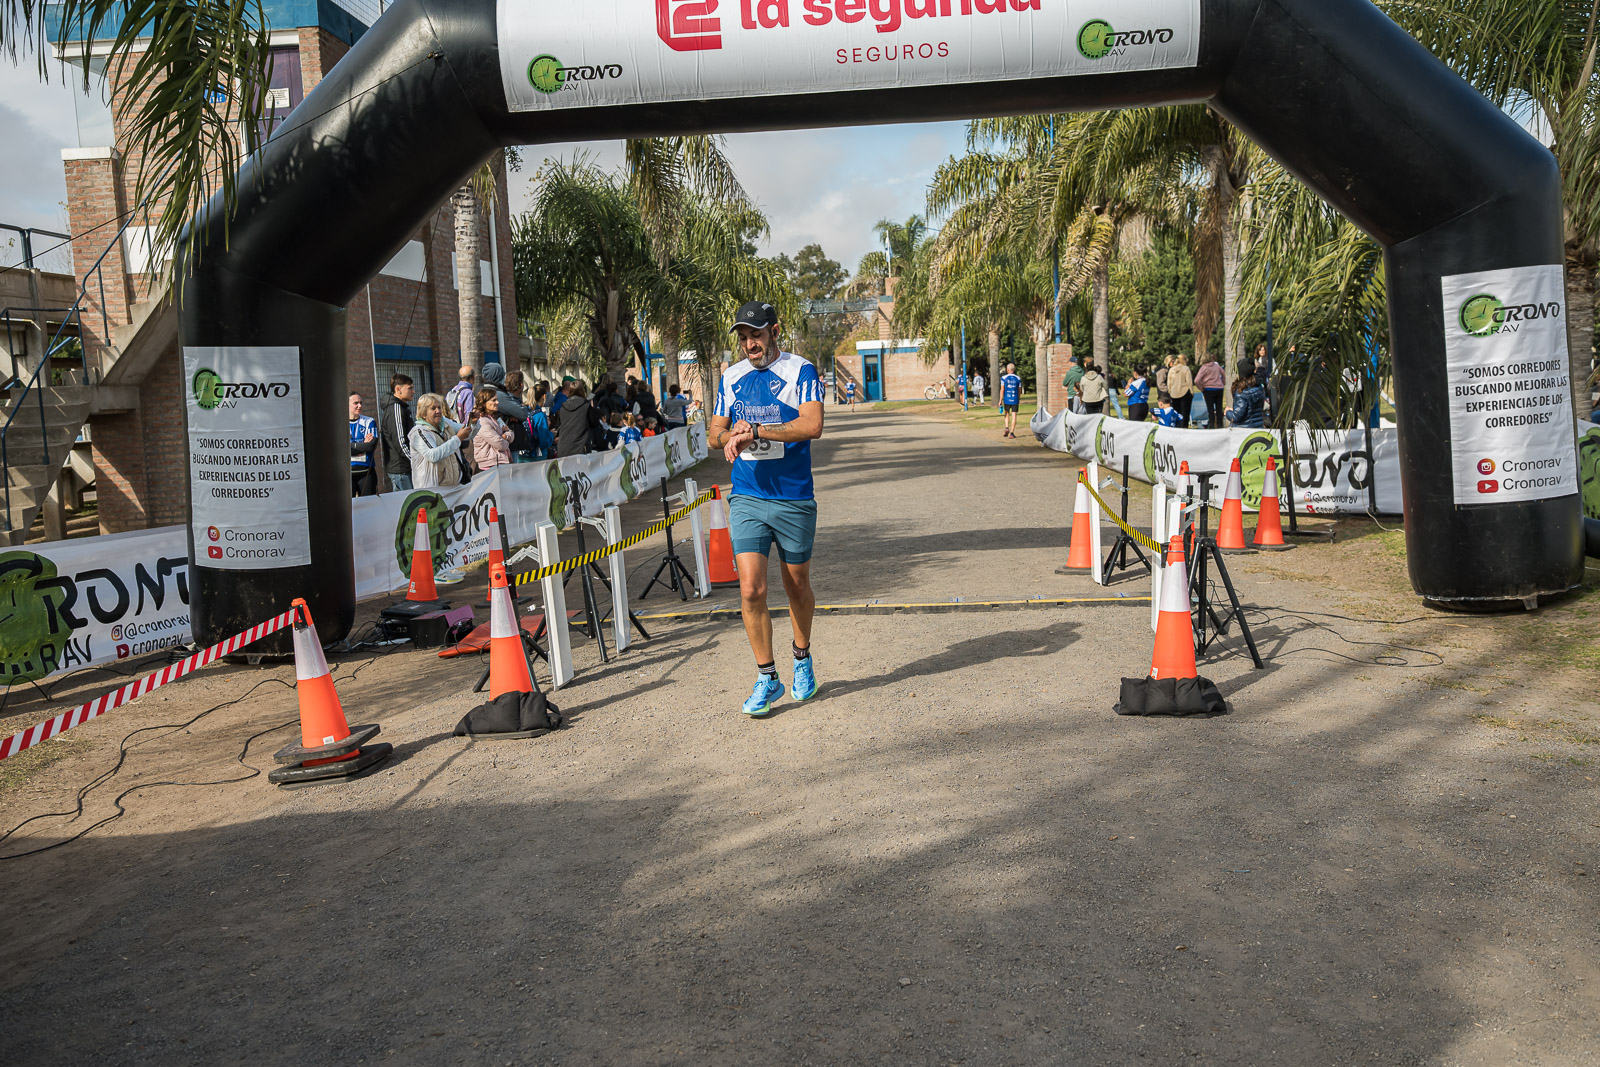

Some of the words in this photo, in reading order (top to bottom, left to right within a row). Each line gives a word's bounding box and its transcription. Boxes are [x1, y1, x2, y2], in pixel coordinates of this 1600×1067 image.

[1103, 28, 1174, 47] CRONO
[836, 41, 949, 64] SEGUROS
[1101, 47, 1127, 58] RAV
[554, 63, 623, 82] CRONO
[554, 82, 579, 92] RAV
[1491, 301, 1561, 324] CRONO
[1490, 323, 1520, 335] RAV
[1507, 360, 1561, 375] CORREDORES
[213, 382, 290, 398] CRONO
[1455, 382, 1512, 397] BUSCANDO
[1514, 378, 1556, 392] MEJORAR
[1557, 376, 1567, 387] LAS
[212, 400, 238, 409] RAV
[1466, 397, 1538, 413] EXPERIENCIAS
[1539, 396, 1550, 407] DE
[1551, 393, 1563, 405] LOS
[226, 437, 289, 449] CORREDORES
[193, 454, 232, 466] BUSCANDO
[233, 454, 279, 466] MEJORAR
[281, 453, 299, 464] LAS
[1502, 456, 1562, 473] Cronorav
[199, 471, 256, 482] EXPERIENCIAS
[258, 471, 271, 482] DE
[273, 470, 290, 481] LOS
[1502, 474, 1562, 490] Cronorav
[224, 529, 285, 542] Cronorav
[225, 546, 286, 559] Cronorav
[124, 613, 191, 639] @cronorav
[132, 633, 184, 656] cronorav
[40, 633, 93, 674] RAV
